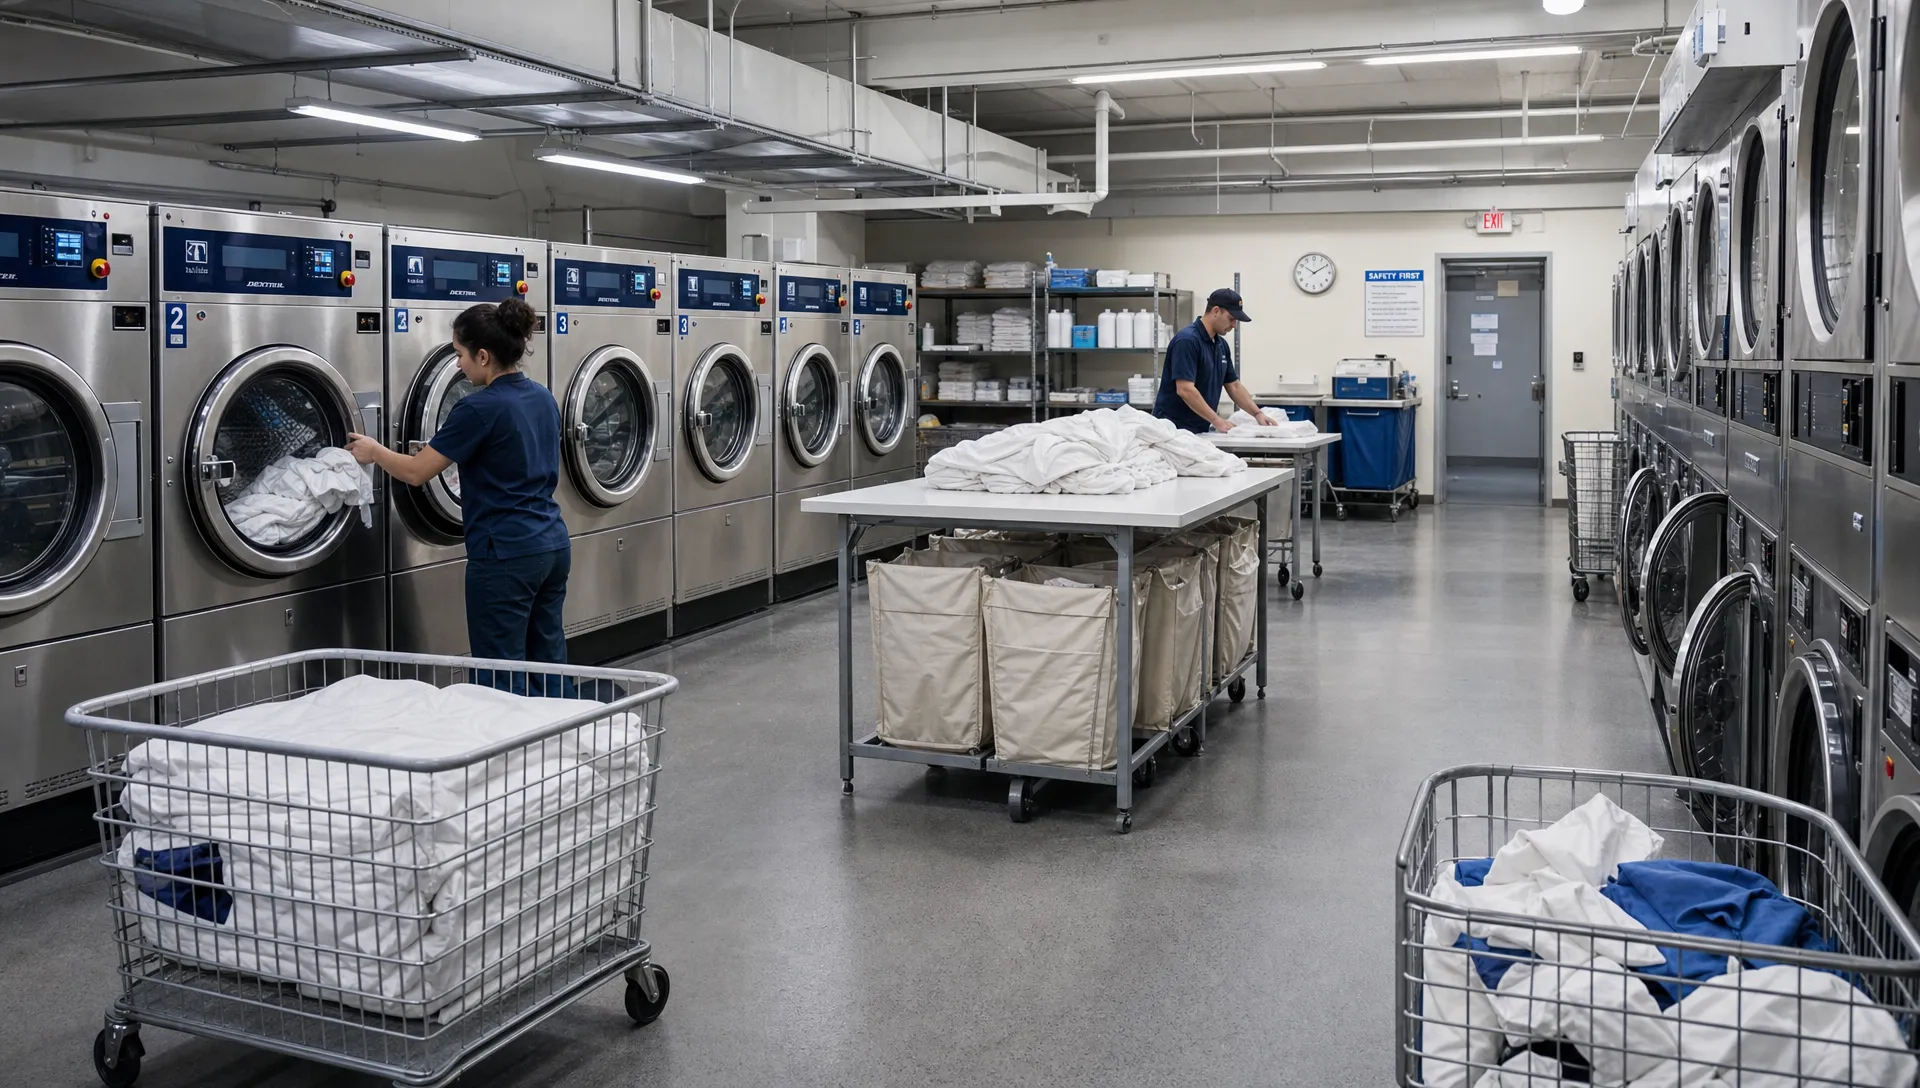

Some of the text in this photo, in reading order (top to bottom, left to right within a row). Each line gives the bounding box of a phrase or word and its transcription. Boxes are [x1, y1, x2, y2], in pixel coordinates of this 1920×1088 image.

[1483, 212, 1505, 229] EXIT
[1368, 272, 1421, 280] SAFETY FIRST
[170, 306, 184, 330] 2
[559, 315, 567, 332] 3
[681, 318, 688, 333] 3
